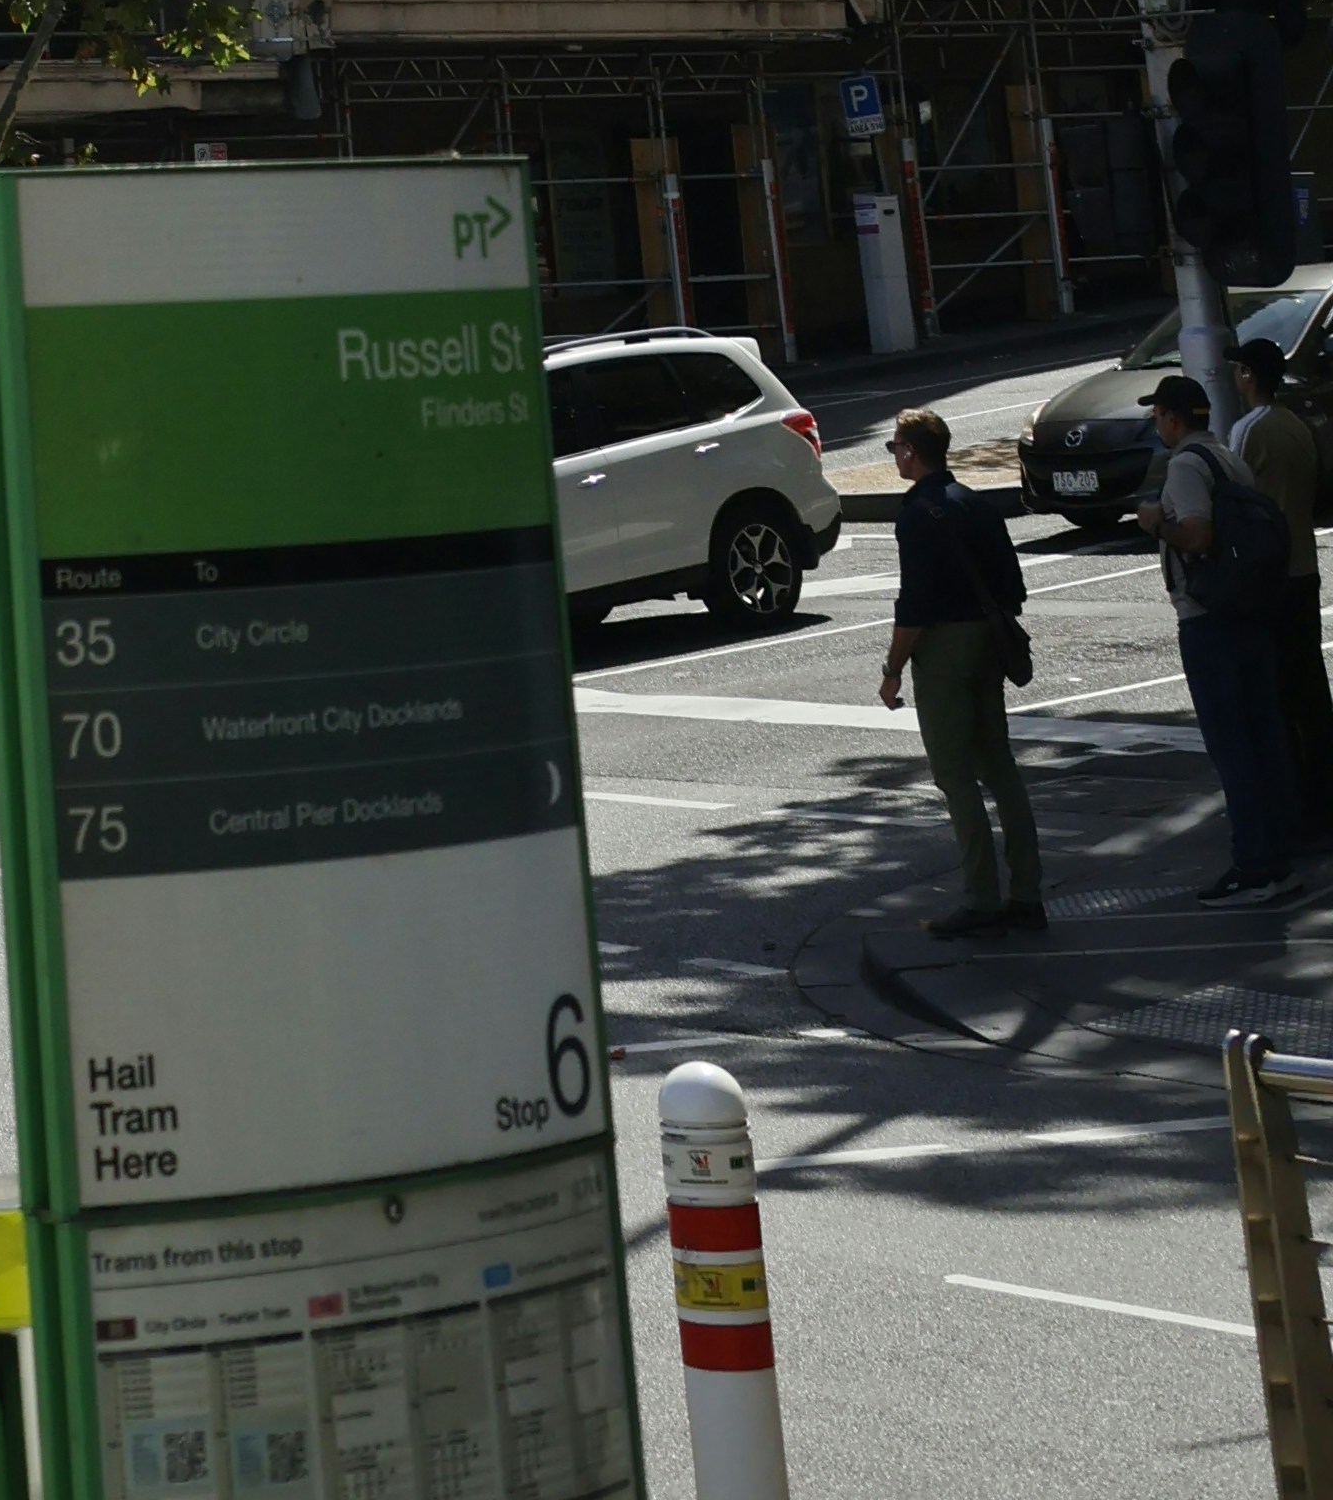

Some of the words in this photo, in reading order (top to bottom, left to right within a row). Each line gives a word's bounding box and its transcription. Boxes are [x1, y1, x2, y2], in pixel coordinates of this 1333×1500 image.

[849, 85, 868, 112] P
[338, 324, 480, 381] Russell
[489, 321, 525, 374] St
[421, 397, 505, 429] Flinders
[509, 392, 528, 424] St
[55, 567, 122, 590] Route
[193, 560, 219, 583] To
[55, 618, 116, 667] 35
[196, 623, 241, 653] City
[247, 619, 310, 648] Circle
[61, 711, 123, 760] 70
[202, 710, 317, 742] Waterfront
[323, 706, 363, 736] City
[368, 698, 464, 730] Docklands
[68, 804, 129, 854] 75
[209, 804, 291, 836] Central
[296, 801, 337, 829] Pier
[343, 791, 444, 824] Docklands
[89, 1052, 156, 1093] Hail
[495, 1095, 550, 1132] Stop
[545, 993, 592, 1119] 6
[91, 1101, 179, 1137] Tram
[94, 1146, 179, 1182] Here
[92, 1251, 157, 1274] Trams
[163, 1245, 214, 1269] from
[218, 1240, 255, 1263] this
[259, 1237, 303, 1259] stop
